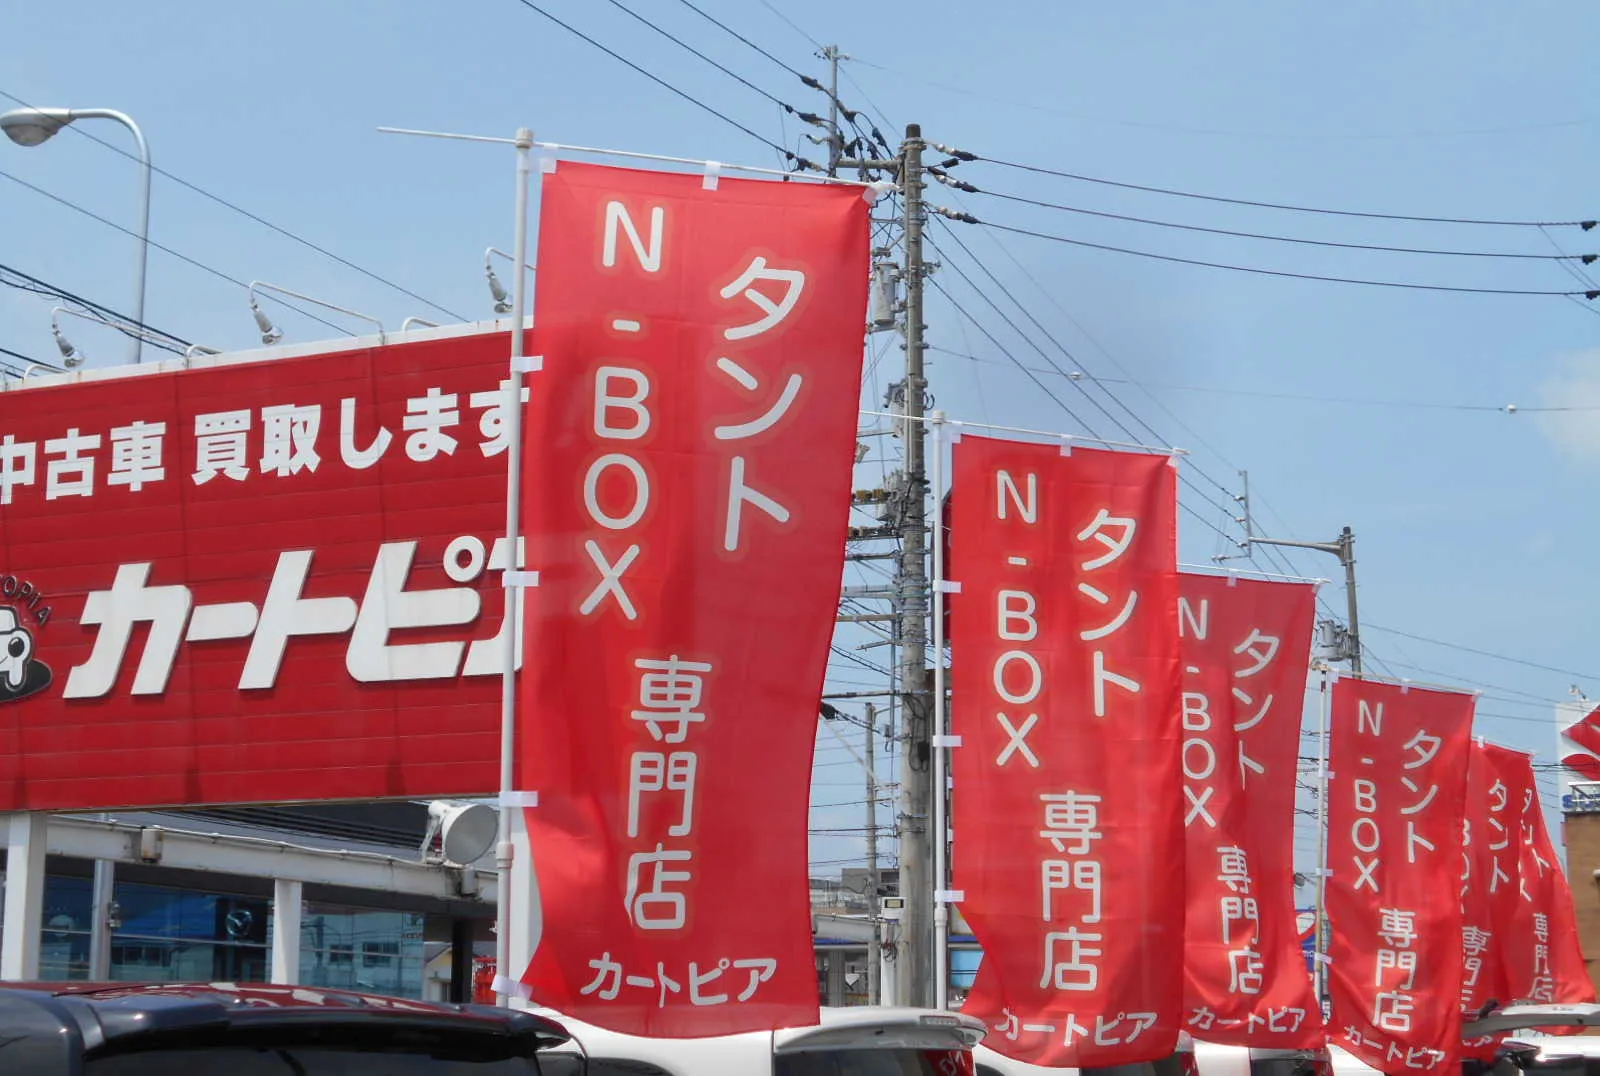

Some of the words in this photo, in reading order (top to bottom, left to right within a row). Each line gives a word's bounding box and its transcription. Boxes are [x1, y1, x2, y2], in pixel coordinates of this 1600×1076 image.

[0, 420, 167, 503] 中古車
[714, 256, 805, 551] タント
[0, 575, 52, 627] OPIA
[579, 201, 664, 620] N-BOX
[624, 654, 712, 929] 専門店
[1077, 508, 1140, 717] タント
[993, 470, 1042, 768] N-BOX
[1039, 789, 1102, 991] 専門店
[1232, 628, 1280, 790] タント
[1177, 597, 1217, 828] N-BOX
[1216, 845, 1265, 995] 専門店
[1400, 729, 1442, 864] タント
[1488, 779, 1509, 893] タント
[1351, 699, 1384, 893] N-BOX
[1371, 907, 1418, 1033] 専門店
[580, 952, 777, 1008] カートピア
[994, 1007, 1158, 1047] カートピア
[1187, 1007, 1306, 1034] カートピア
[1344, 1025, 1446, 1070] カートピア
